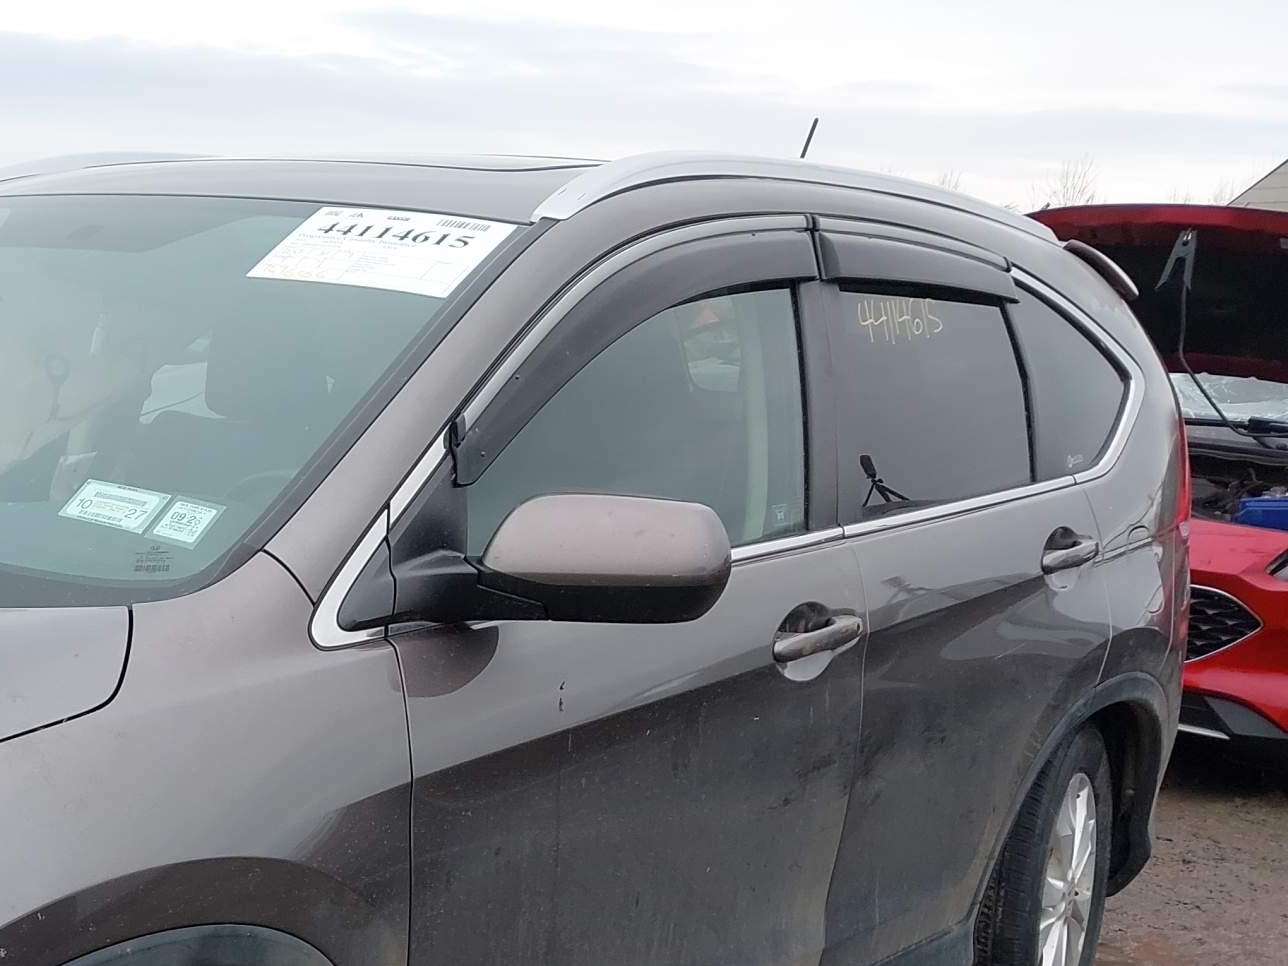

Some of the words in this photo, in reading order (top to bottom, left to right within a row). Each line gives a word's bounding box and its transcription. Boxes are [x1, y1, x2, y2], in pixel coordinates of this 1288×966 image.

[317, 223, 475, 248] 44114615
[76, 498, 93, 510] 10
[124, 508, 149, 521] 27
[170, 511, 187, 523] 09
